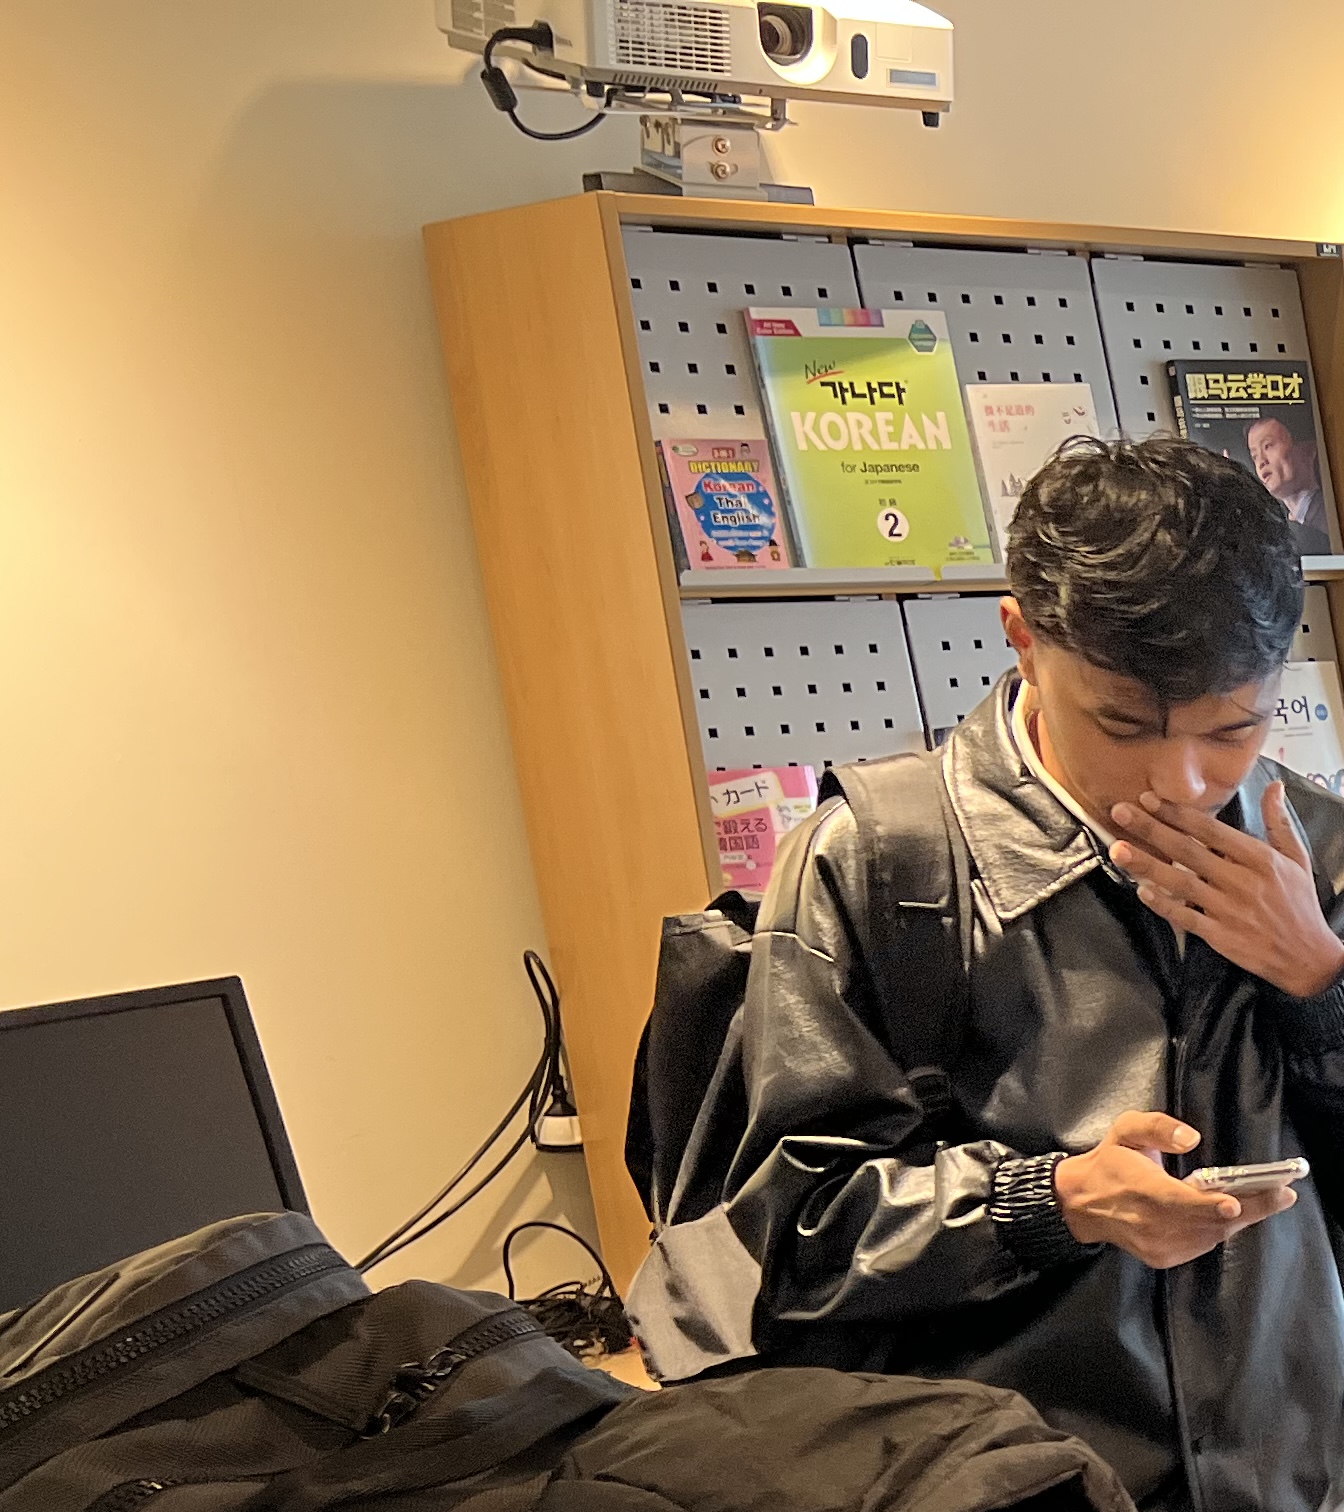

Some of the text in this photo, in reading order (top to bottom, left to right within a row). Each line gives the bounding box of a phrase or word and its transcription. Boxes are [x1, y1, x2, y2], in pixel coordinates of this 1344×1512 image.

[804, 360, 836, 379] New
[820, 381, 907, 405] 가나다
[1185, 373, 1304, 399] 跟马云学口才
[790, 411, 952, 451] KOREAN
[689, 461, 760, 473] DICTIONARY
[841, 461, 920, 475] for Japanese
[703, 481, 755, 492] Korean
[715, 496, 747, 507] Thai
[712, 512, 761, 525] English
[884, 513, 903, 538] 2
[1274, 696, 1310, 724] 국어
